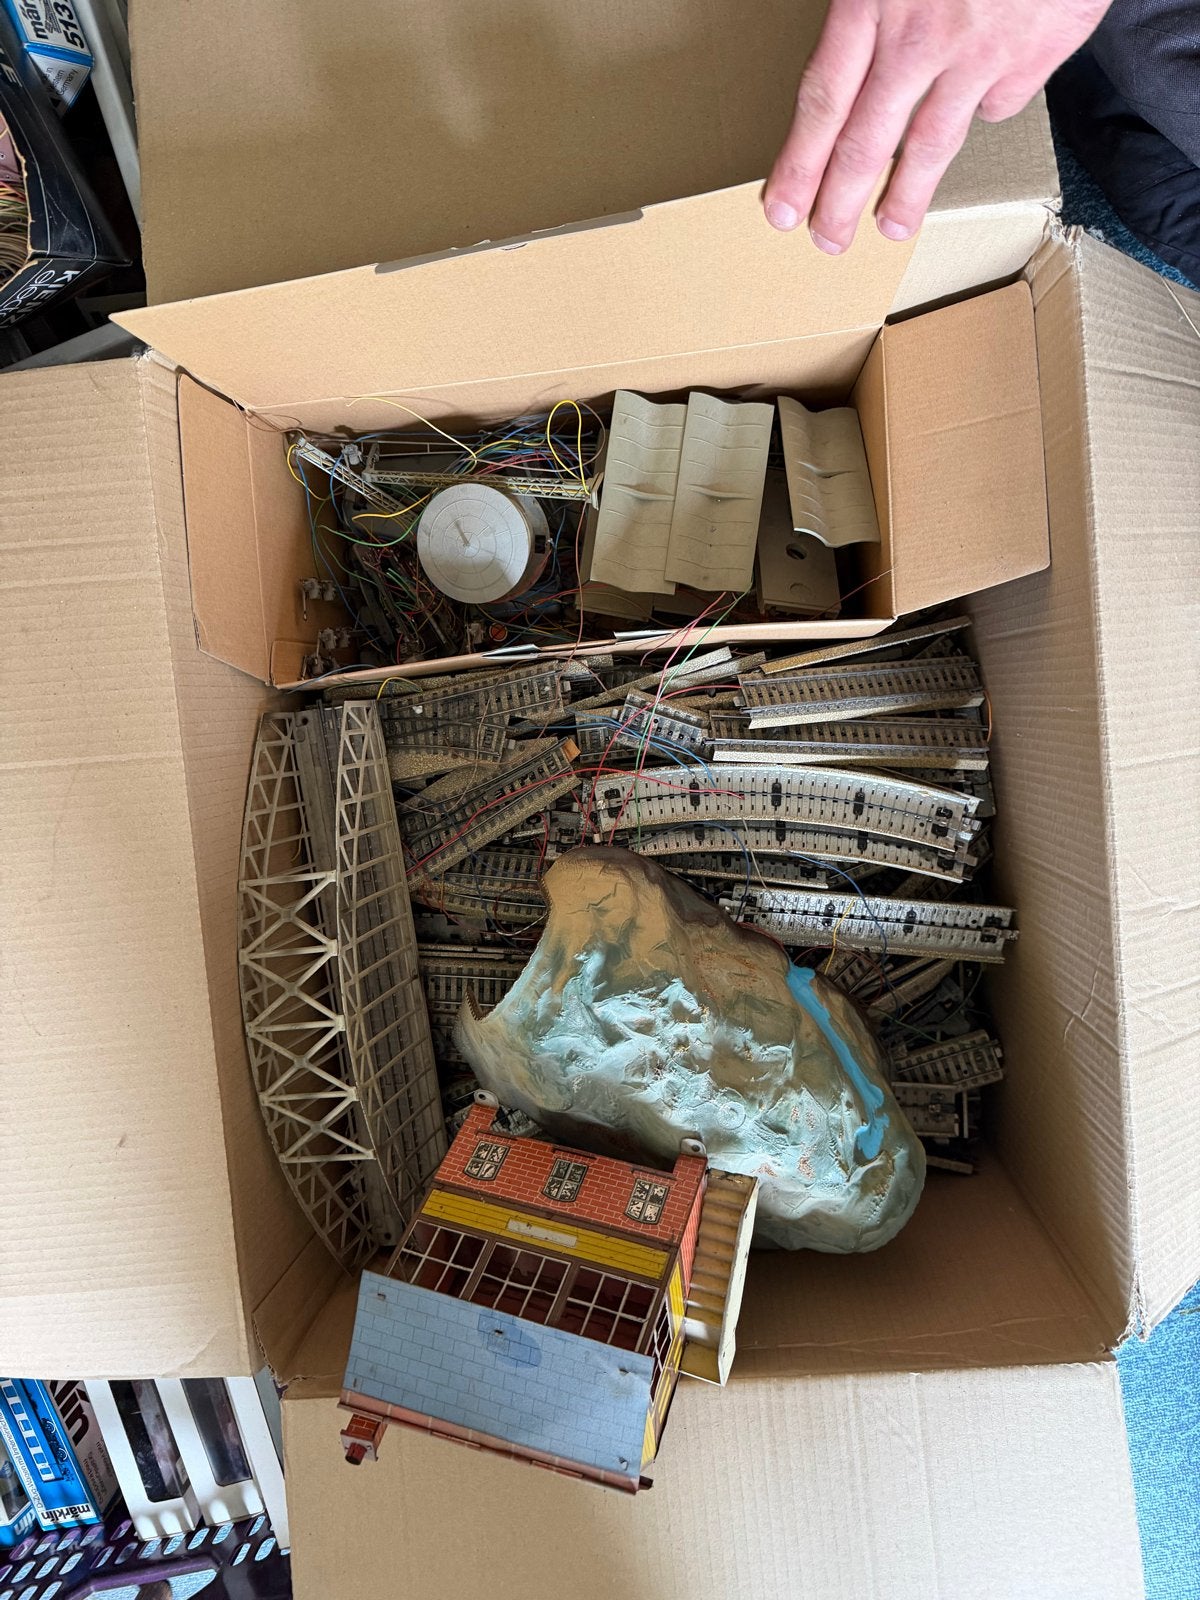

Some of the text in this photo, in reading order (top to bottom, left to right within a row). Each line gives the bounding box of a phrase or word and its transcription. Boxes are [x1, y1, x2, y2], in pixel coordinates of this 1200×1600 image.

[53, 0, 85, 49] 513
[56, 68, 79, 96] Germany
[0, 270, 81, 330] KIENZ
[40, 1504, 91, 1522] märklin
